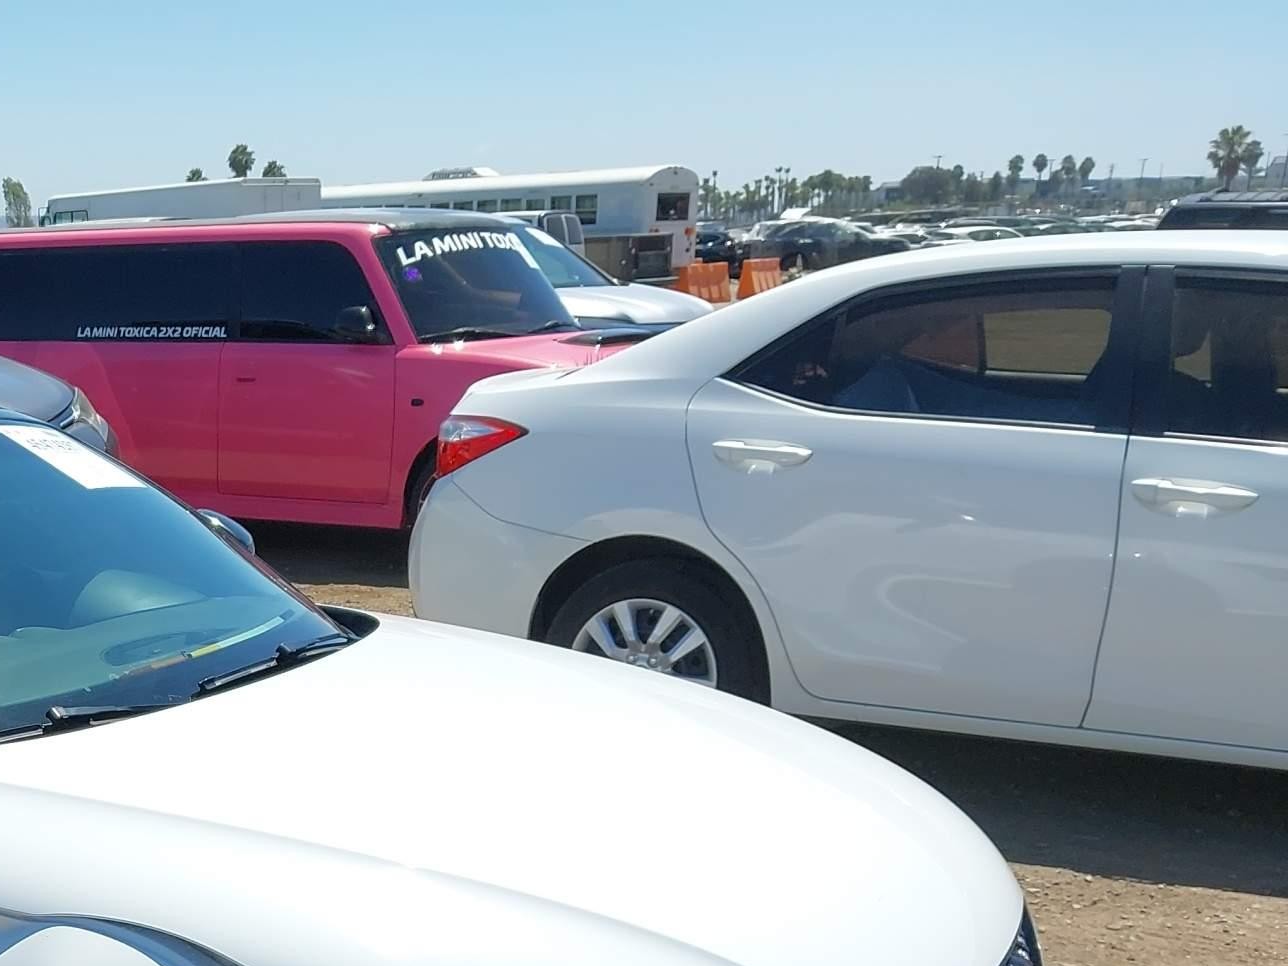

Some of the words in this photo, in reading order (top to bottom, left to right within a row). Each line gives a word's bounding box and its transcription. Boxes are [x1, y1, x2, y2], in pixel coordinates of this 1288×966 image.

[396, 240, 434, 267] LA
[432, 231, 485, 255] MINI
[91, 326, 118, 338] MINI
[118, 326, 158, 338] TOXICA
[158, 326, 182, 338] 2X2
[182, 326, 228, 338] OFICIAL
